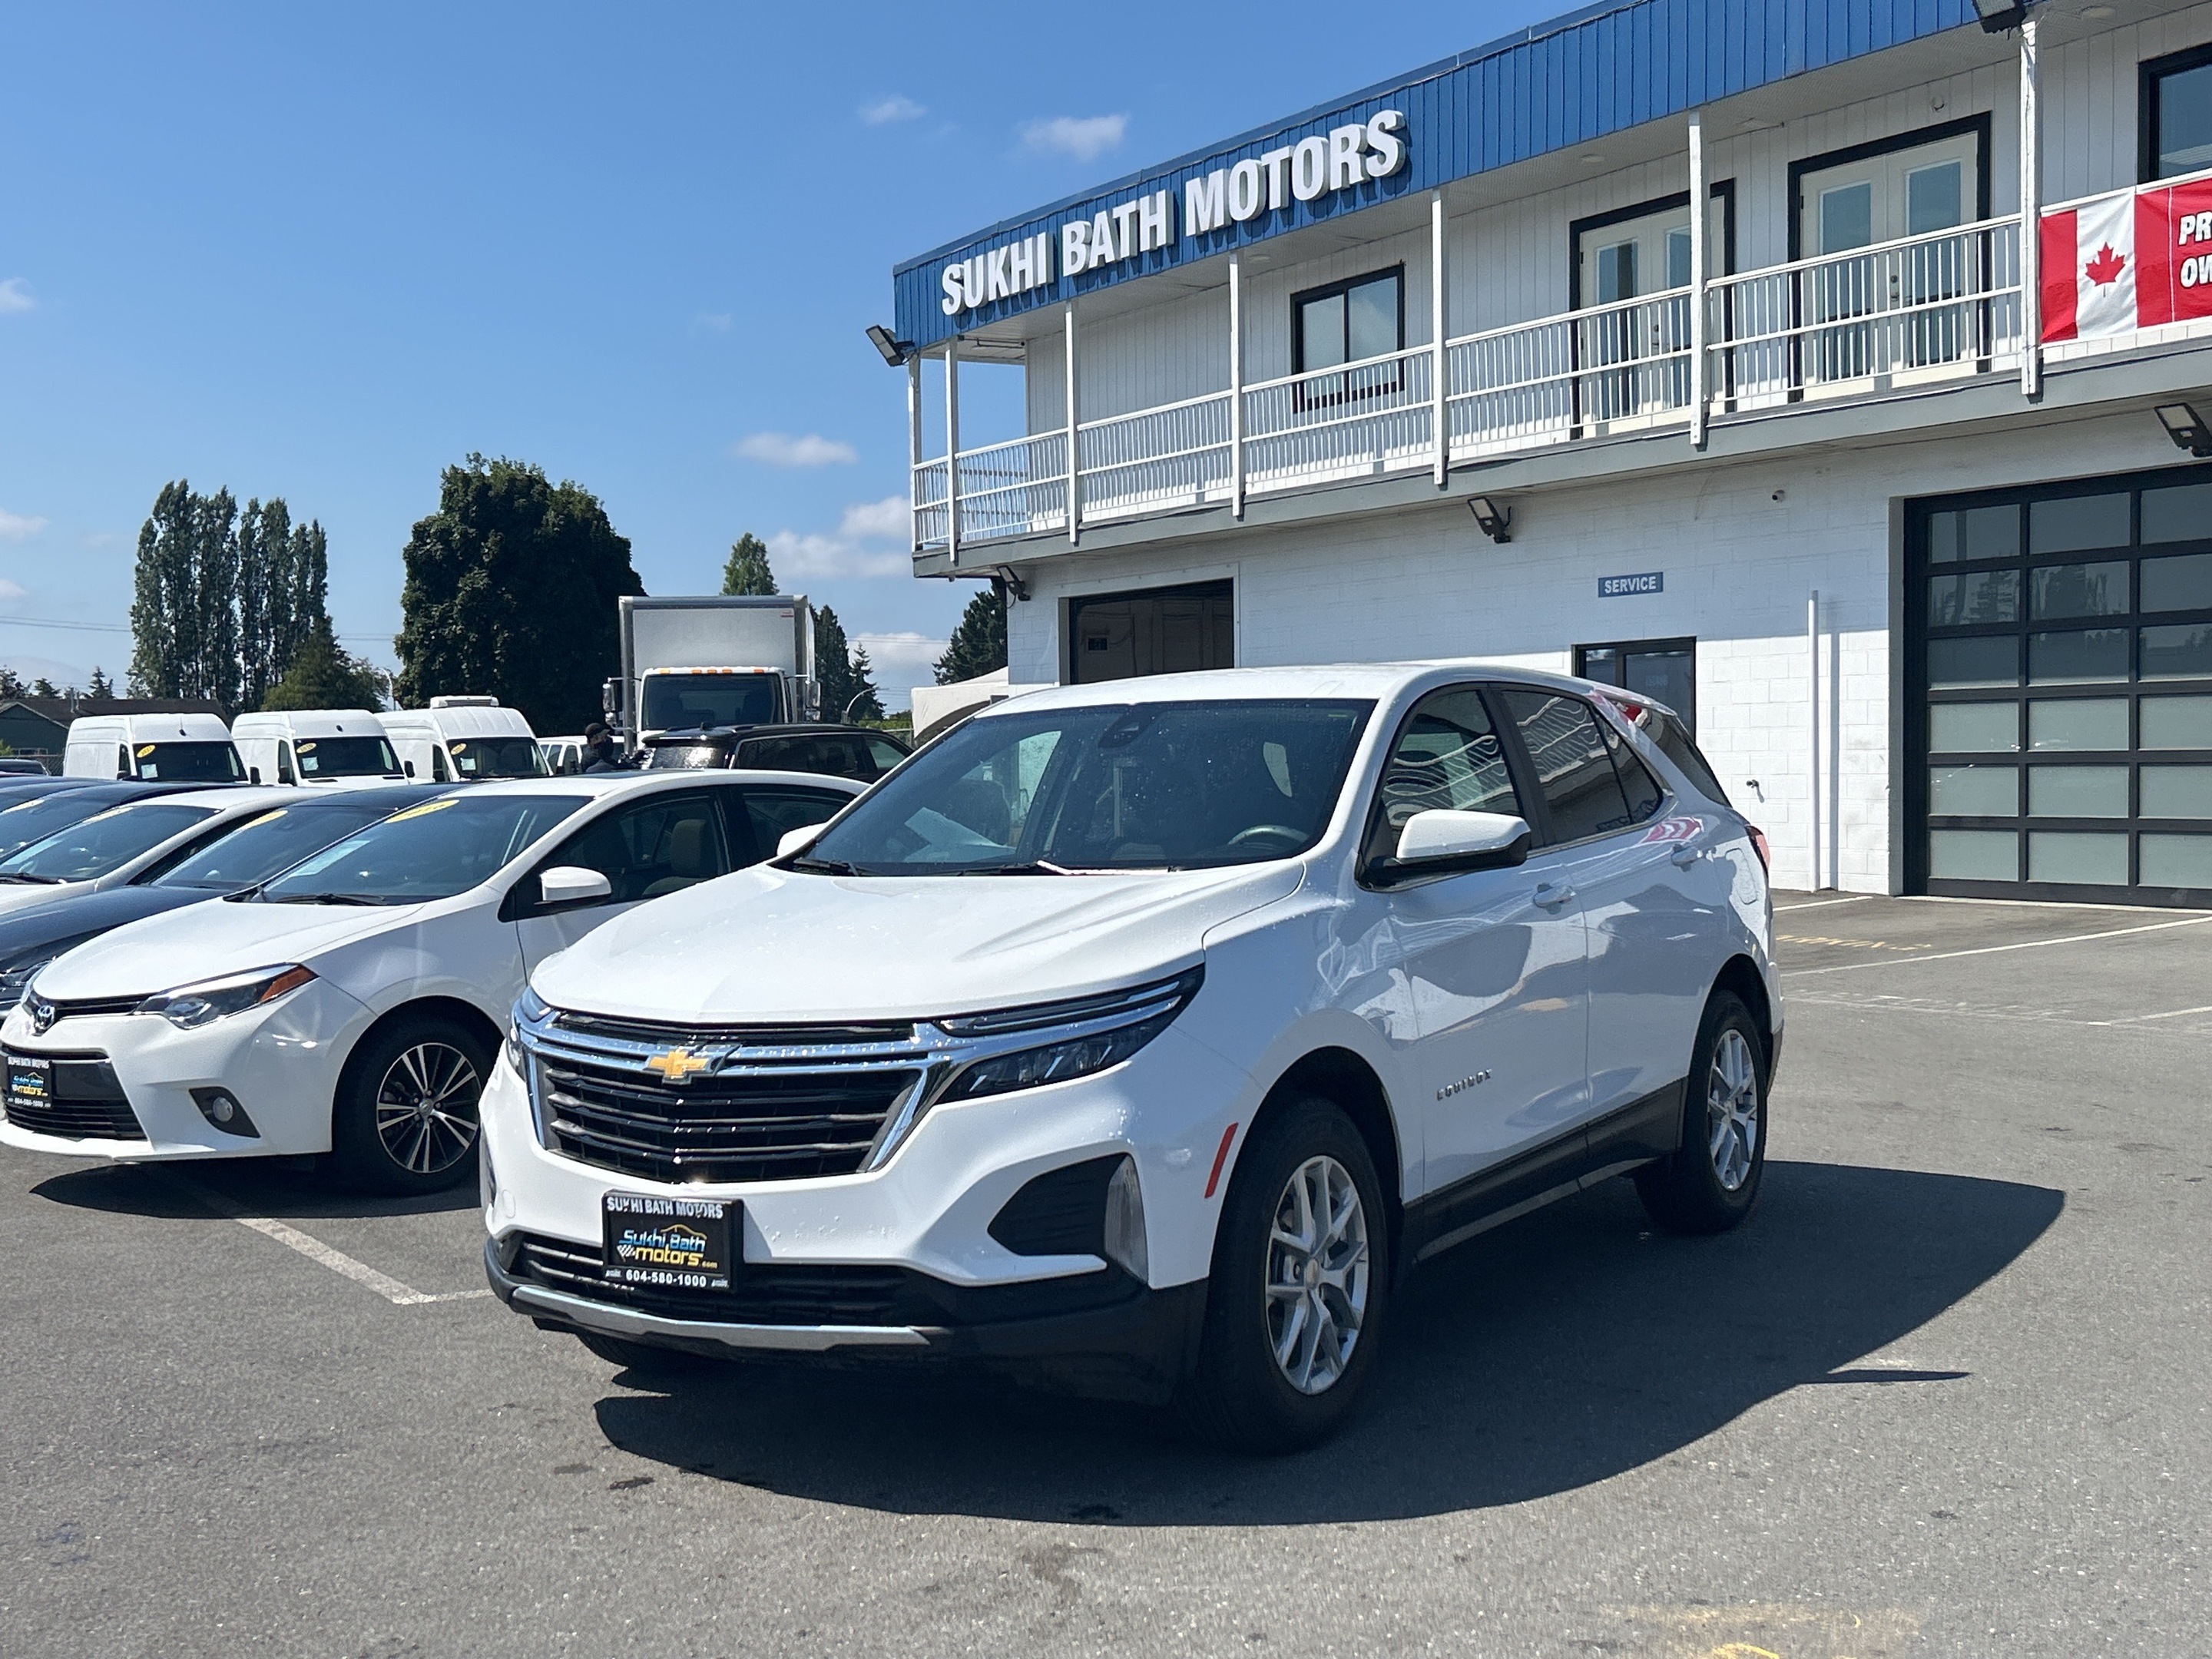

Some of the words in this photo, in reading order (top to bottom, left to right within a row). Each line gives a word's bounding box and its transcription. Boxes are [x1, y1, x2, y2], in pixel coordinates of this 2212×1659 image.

[941, 231, 1055, 316] SUKHI
[1062, 190, 1174, 278] BATH
[1185, 109, 1406, 237] MOTORS
[1604, 576, 1657, 594] SERVICE
[644, 1198, 674, 1216] BATH
[618, 1228, 666, 1247] Sukhi
[670, 1233, 706, 1252] Bath
